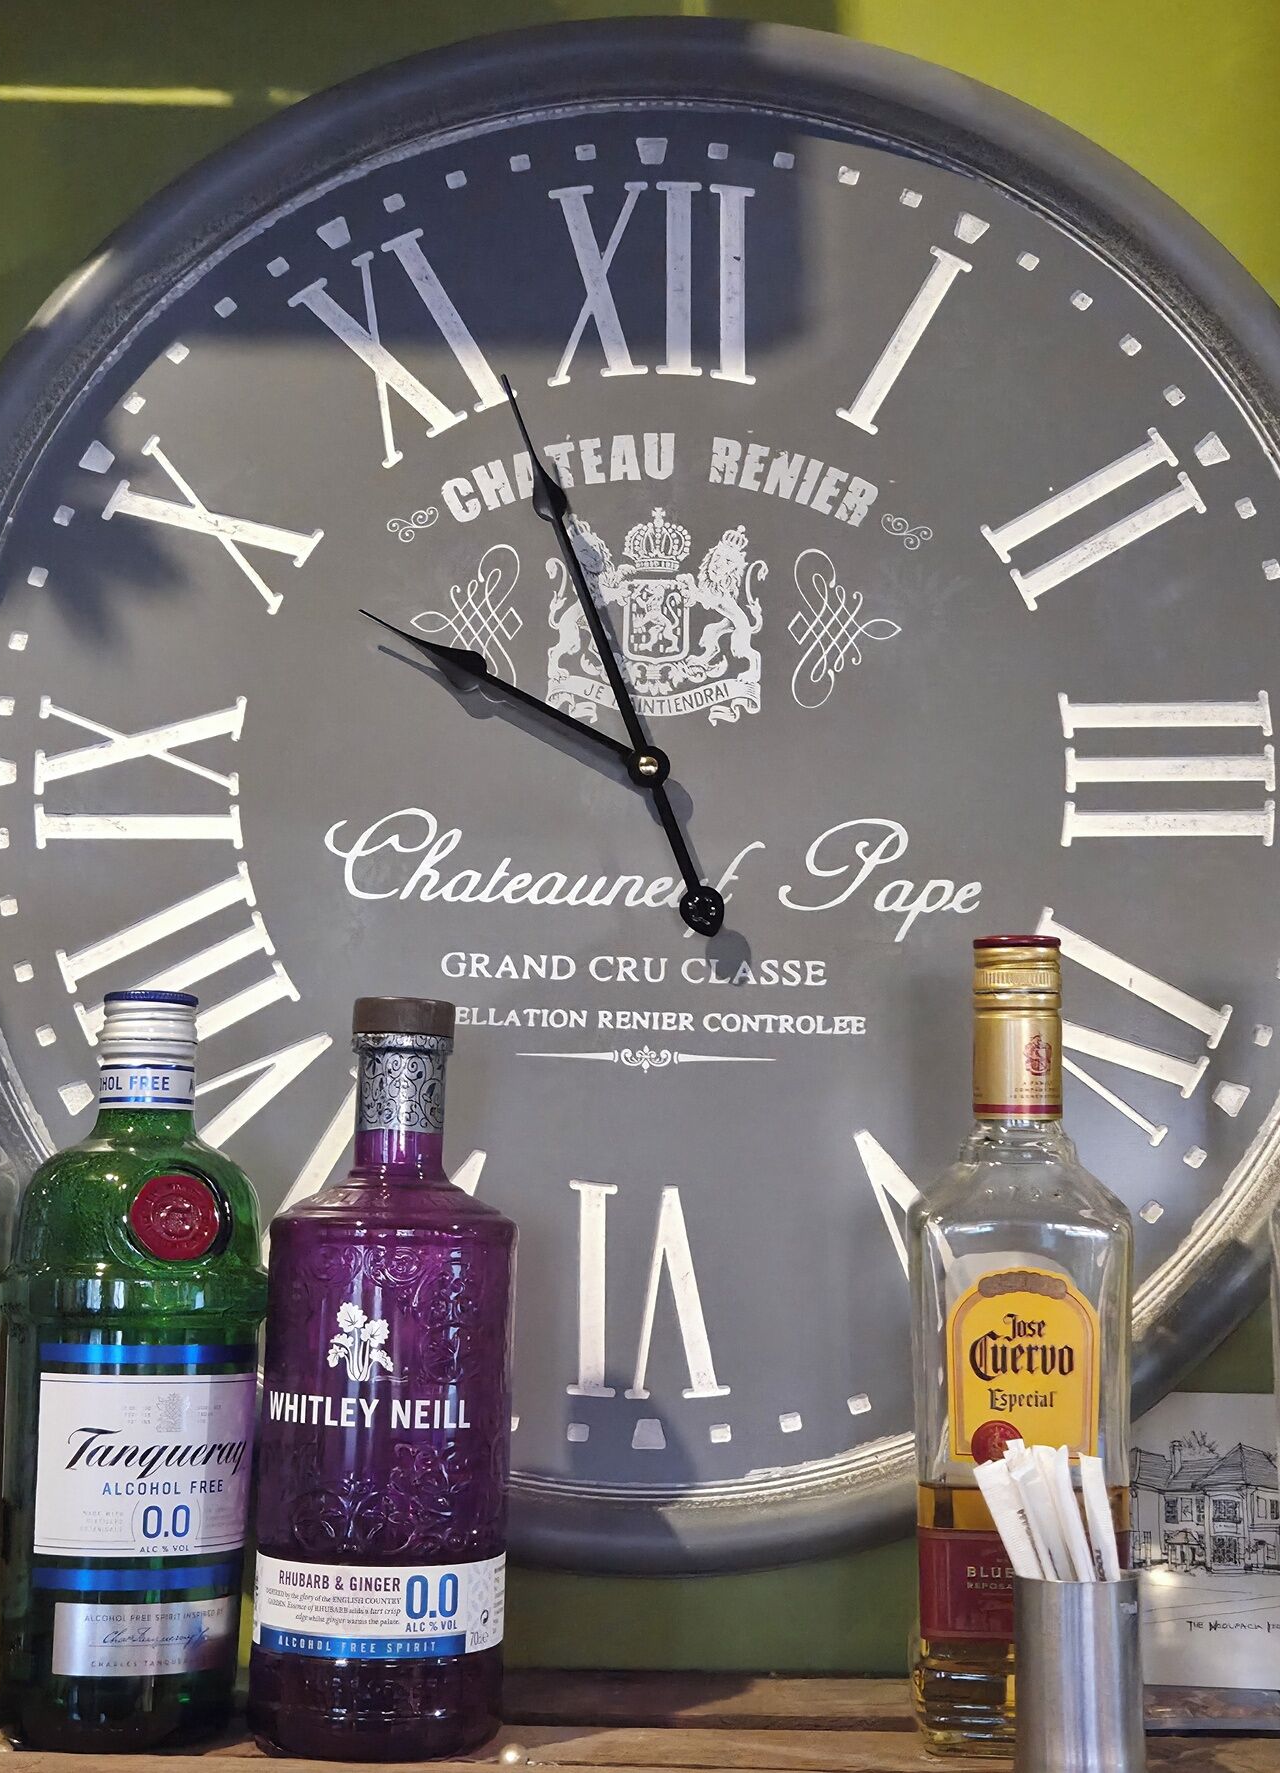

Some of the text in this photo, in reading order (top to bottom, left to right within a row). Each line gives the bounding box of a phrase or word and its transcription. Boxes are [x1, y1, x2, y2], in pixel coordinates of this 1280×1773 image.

[708, 436, 879, 527] RENIER
[611, 682, 729, 715] INTIENDRAI
[778, 817, 982, 942] Pape
[441, 951, 828, 986] GRAND CRU CLASSE
[454, 1007, 867, 1035] ELLATION RENIER CONTROLEE
[128, 1075, 171, 1092] FREE
[1002, 1312, 1047, 1344] Jose
[969, 1330, 1076, 1382] Cuervo
[269, 1390, 471, 1430] WHITLEY NEILL
[986, 1387, 1058, 1412] Especial
[65, 1426, 247, 1480] Tanqueray
[102, 1479, 224, 1496] ALCOHOL FREE
[142, 1503, 191, 1540] 0.0
[139, 1544, 160, 1554] ALC
[172, 1543, 190, 1553] VOL
[278, 1569, 401, 1592] RHUBARB & GINGER
[966, 1581, 1014, 1590] REPOSA
[364, 1597, 401, 1605] COUNTRY
[405, 1573, 459, 1620] 0.0
[84, 1613, 127, 1623] ALCOHOL
[130, 1613, 151, 1622] FREE
[405, 1619, 458, 1633] ALC % VOL
[278, 1634, 438, 1653] ALCOHOL FREE SPIRIT
